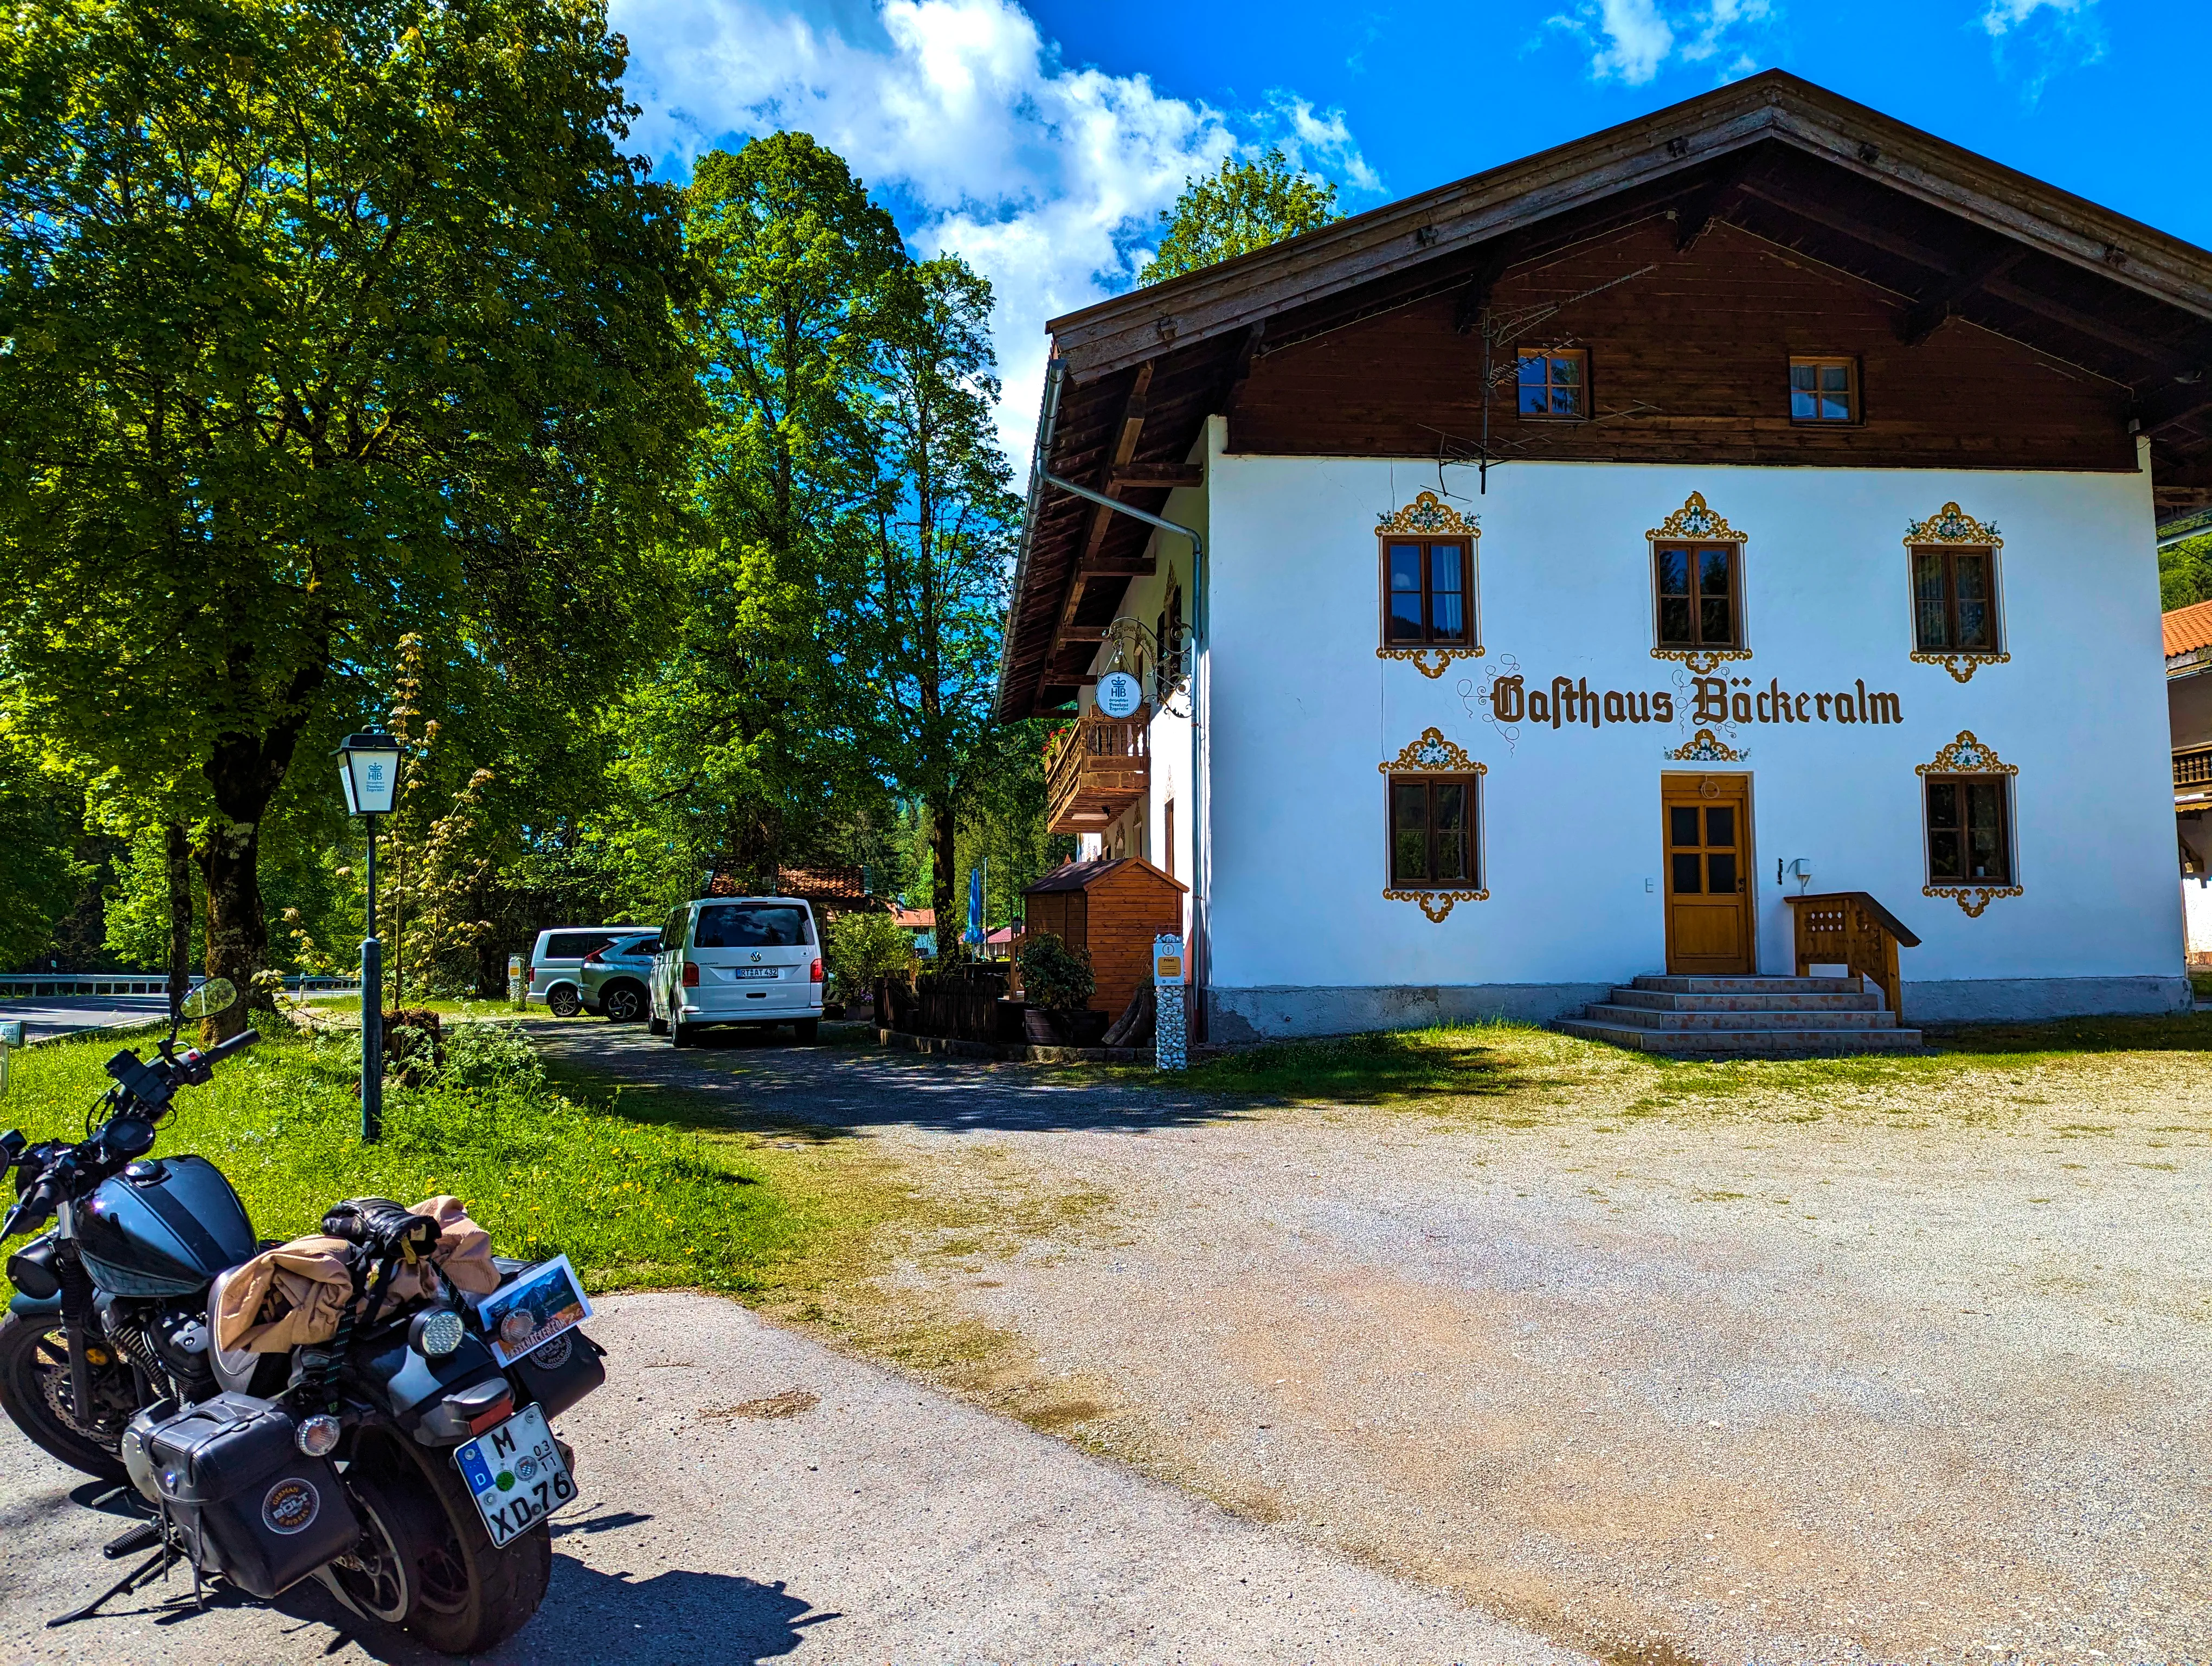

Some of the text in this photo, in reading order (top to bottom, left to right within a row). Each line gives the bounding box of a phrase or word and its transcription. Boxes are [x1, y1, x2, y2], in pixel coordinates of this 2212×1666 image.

[1111, 686, 1127, 698] HTB
[1691, 676, 1903, 724] Böckeralm
[368, 771, 382, 780] HTB
[536, 1336, 562, 1358] BOLT
[491, 1426, 517, 1459] M
[533, 1440, 550, 1457] 03
[541, 1456, 556, 1472] 11
[474, 1472, 486, 1486] D
[273, 1486, 299, 1505] GERMAN
[272, 1491, 310, 1520] BOLT
[490, 1472, 571, 1541] XD 76
